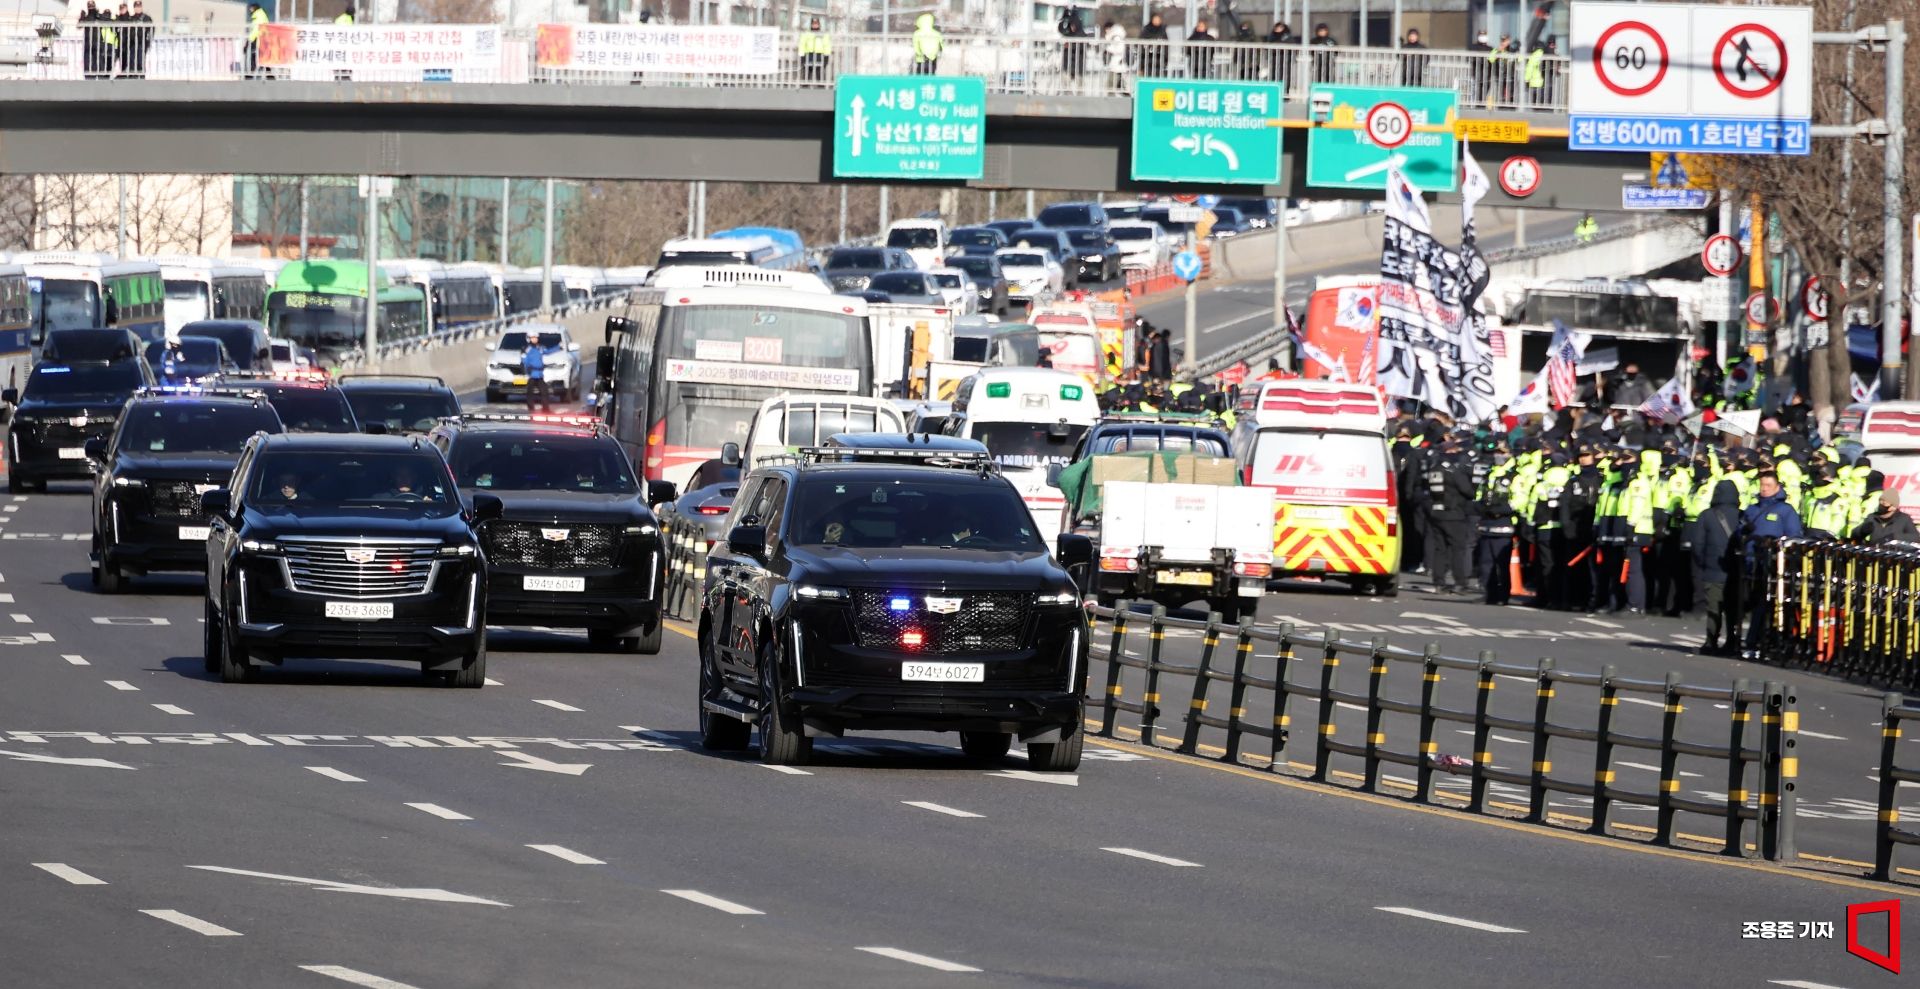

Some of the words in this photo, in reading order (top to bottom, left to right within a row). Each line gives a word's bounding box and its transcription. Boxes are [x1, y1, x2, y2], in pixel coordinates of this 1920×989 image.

[438, 31, 463, 45] 간첩
[296, 49, 347, 63] 내란세력
[351, 50, 402, 64] 민주당을
[407, 50, 464, 64] 체포하라!
[611, 51, 634, 65] 전원
[1615, 46, 1646, 70] 60
[876, 88, 916, 110] 시청
[1175, 89, 1268, 115] 이태원역
[919, 104, 947, 120] City
[952, 105, 979, 118] Hall
[1174, 114, 1221, 128] Itaewon
[1223, 115, 1266, 129] Station
[1376, 116, 1402, 135] 60
[875, 122, 978, 144] 남산1호터널
[1576, 121, 1683, 146] 전방600m
[1688, 123, 1804, 149] 1호터널구간
[748, 340, 783, 361] 3201
[698, 367, 726, 378] 2025
[802, 372, 852, 386] 신입생모집
[994, 454, 1073, 468] AMBULANC
[1293, 488, 1346, 497] AMBULANCE
[555, 579, 582, 590] 6047
[361, 605, 390, 616] 3688
[945, 666, 979, 680] 6027
